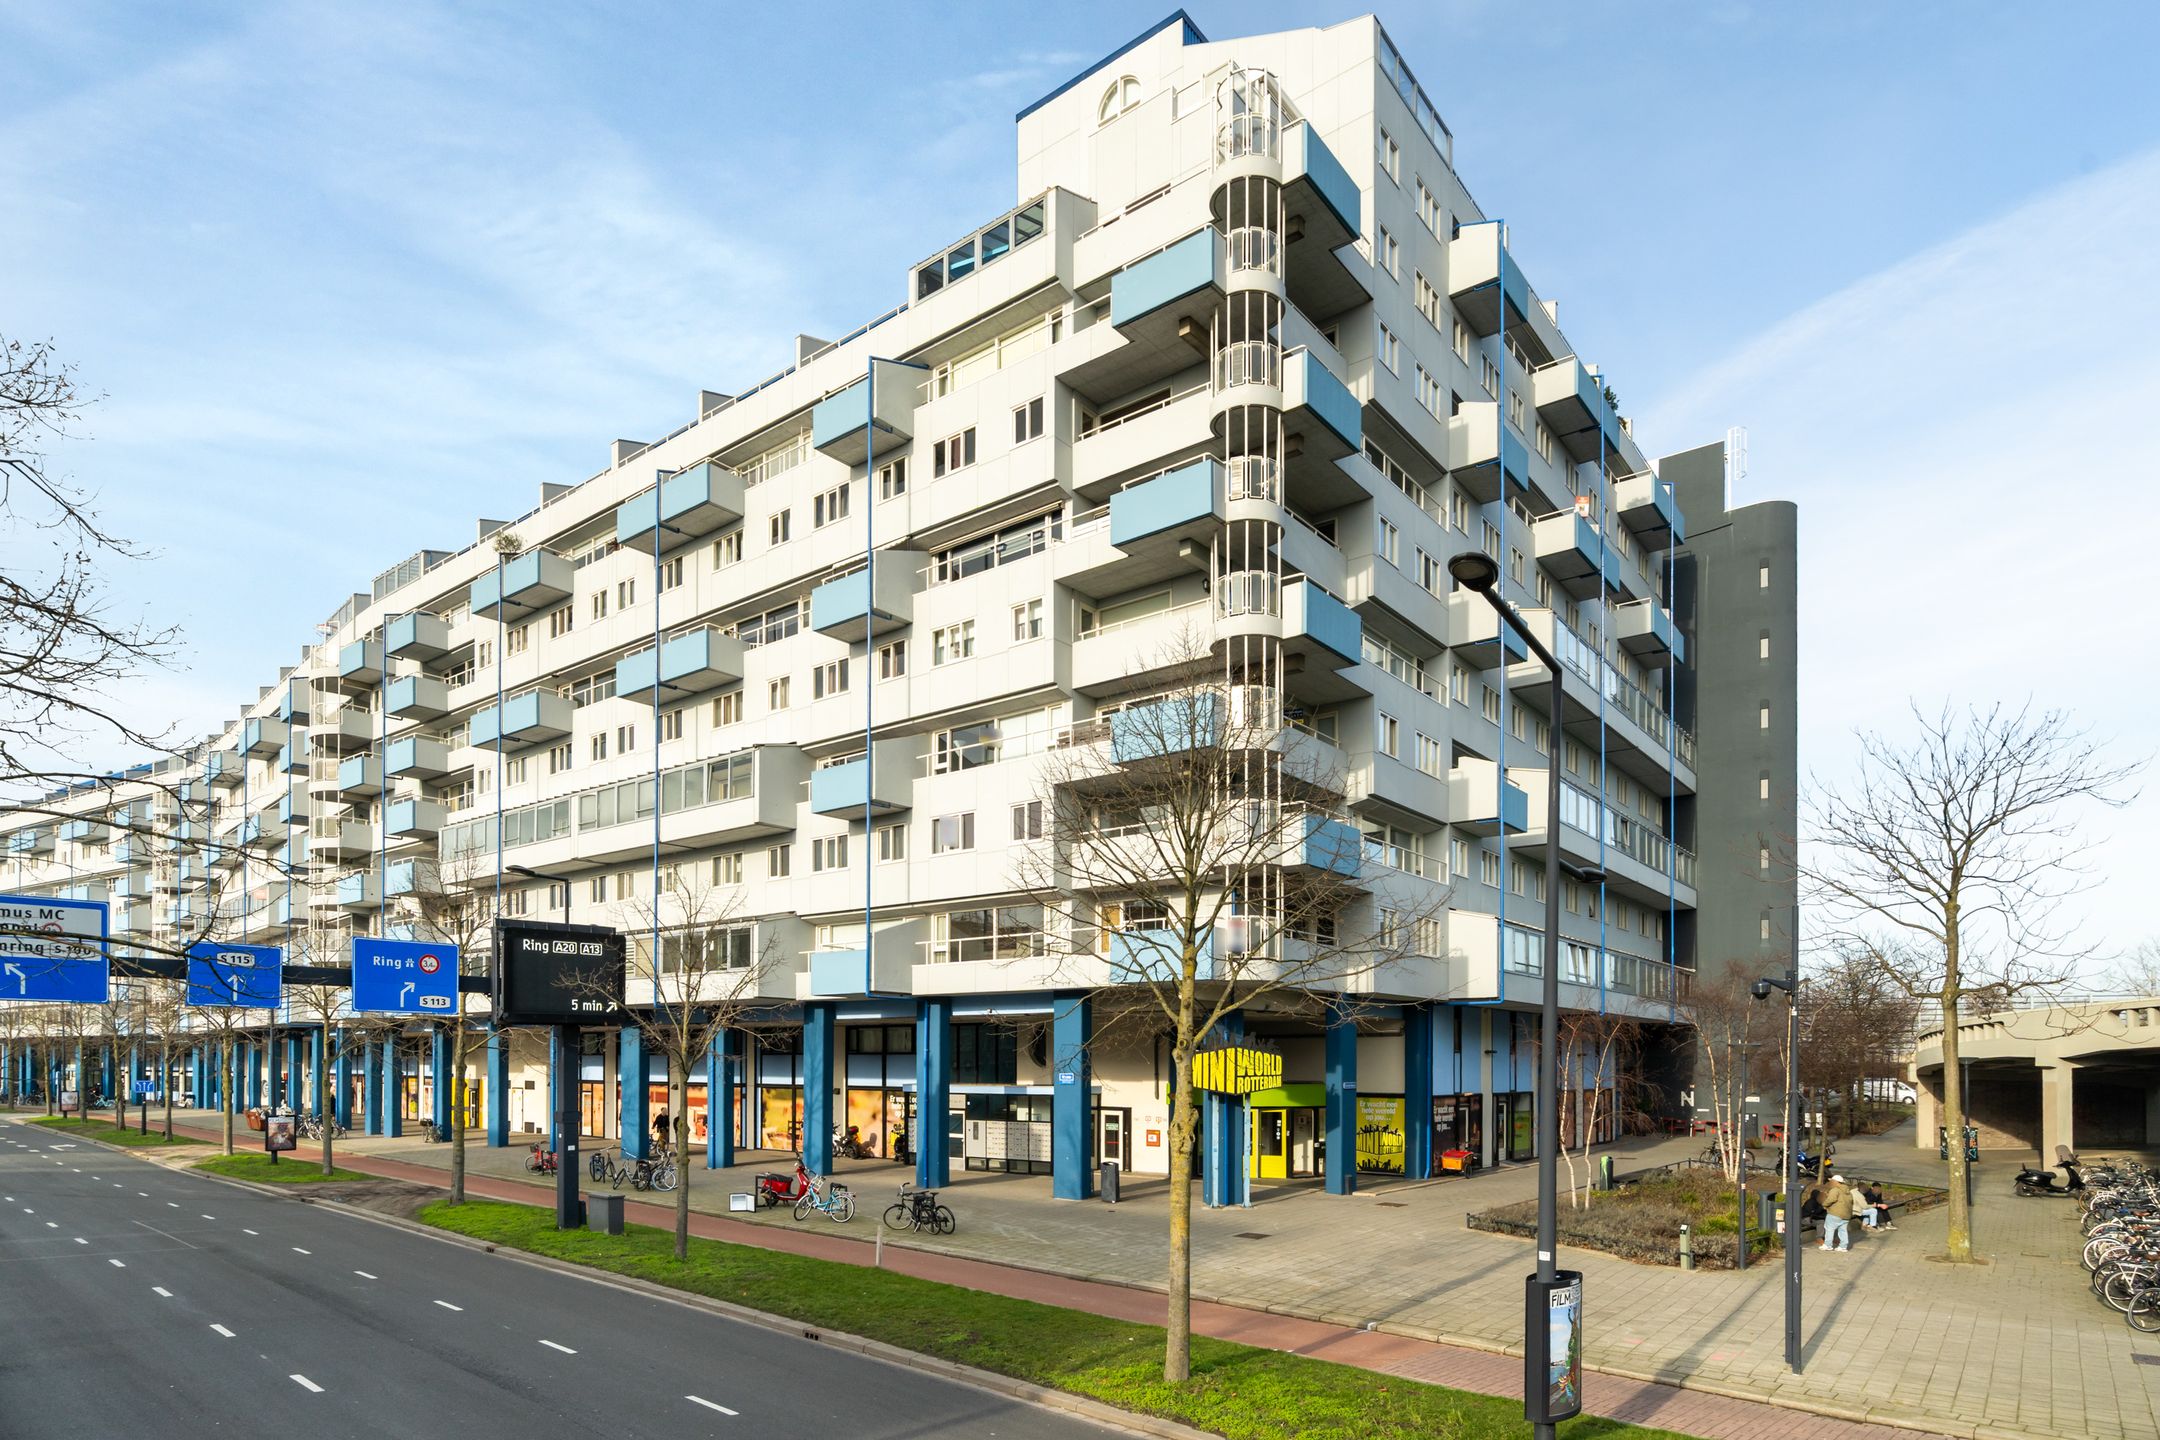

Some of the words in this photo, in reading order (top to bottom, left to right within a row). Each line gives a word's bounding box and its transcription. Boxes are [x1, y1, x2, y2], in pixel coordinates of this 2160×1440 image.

[40, 909, 65, 920] MC
[523, 938, 549, 954] Ring
[555, 943, 575, 952] A20
[582, 945, 600, 954] A13
[220, 954, 227, 963] S
[231, 955, 250, 964] 115
[373, 956, 402, 970] Ring
[422, 997, 429, 1006] S
[431, 998, 447, 1006] 113
[571, 999, 579, 1011] 5
[582, 1000, 603, 1012] min
[1192, 1047, 1236, 1095] MINI
[1237, 1047, 1283, 1076] WORLD
[1237, 1076, 1283, 1095] ROTTERDAM
[1552, 1293, 1570, 1307] FILM
